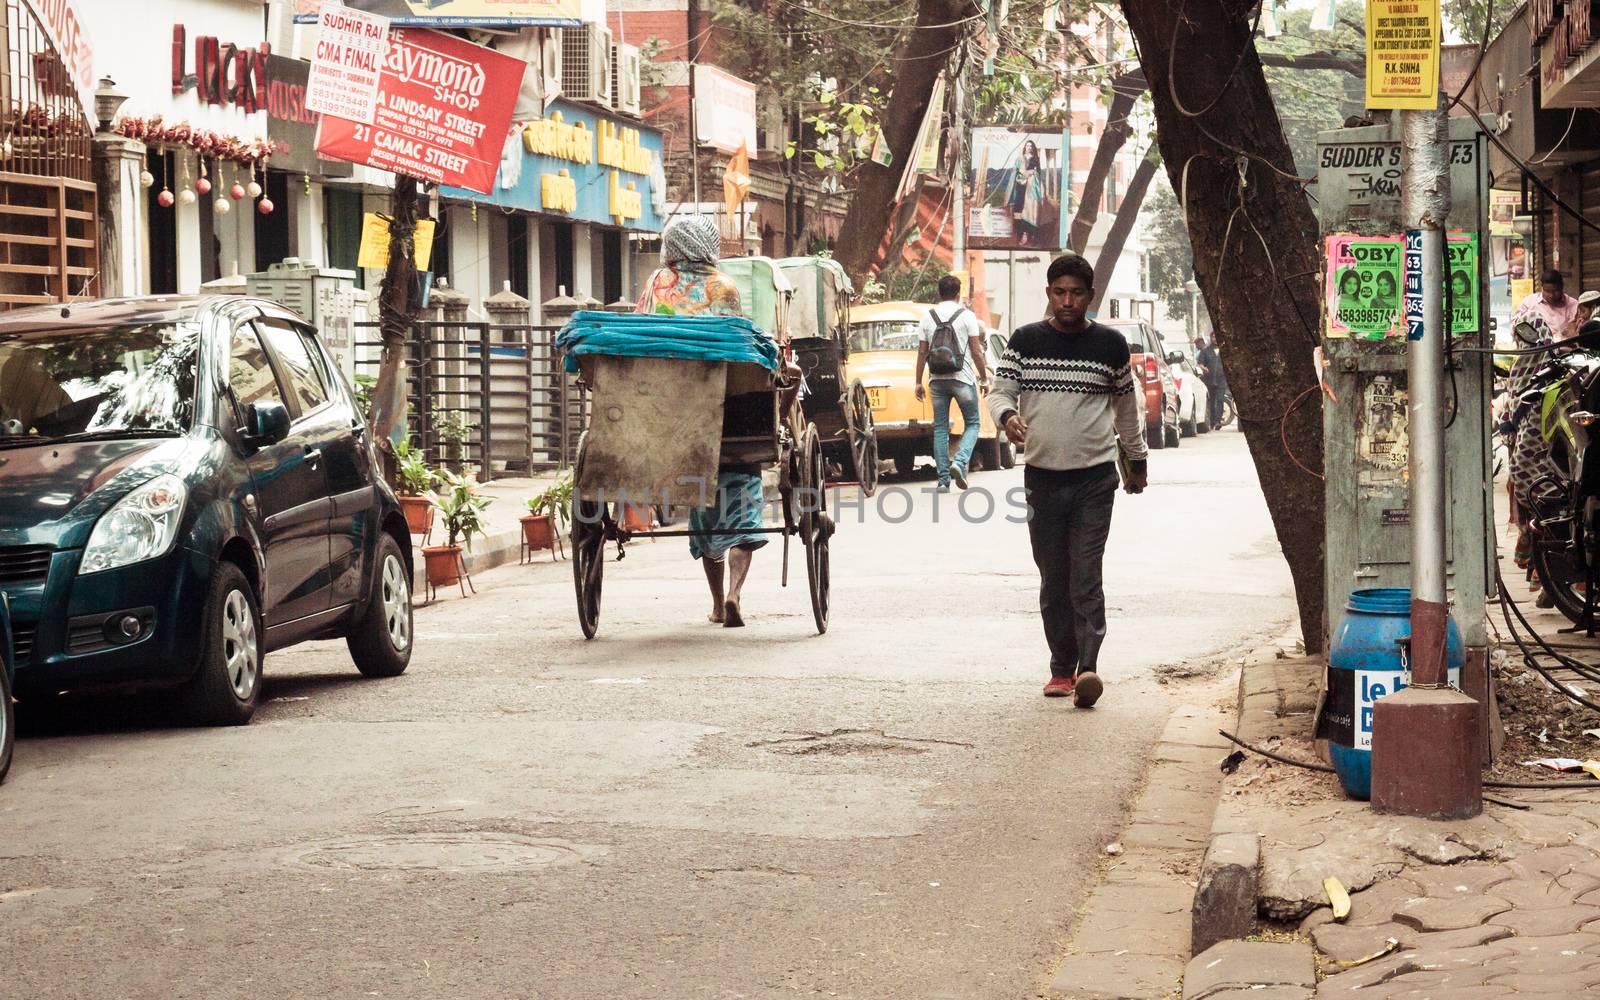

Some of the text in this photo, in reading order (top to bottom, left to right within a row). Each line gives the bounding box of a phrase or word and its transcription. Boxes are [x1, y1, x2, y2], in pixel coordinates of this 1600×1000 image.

[323, 13, 383, 40] SUDHIR RAI
[389, 28, 404, 43] HE
[317, 40, 377, 72] CMA FINAL
[374, 39, 486, 97] Raymond
[1385, 62, 1420, 74] R.K. SINHA
[433, 86, 480, 112] SHOP
[389, 94, 443, 123] LINDSAY
[443, 113, 486, 139] STREET
[353, 124, 469, 174] 21 CAMAC STREET
[1320, 146, 1401, 168] SUDDER S
[1341, 244, 1395, 261] ROBY
[1448, 248, 1468, 260] BY
[1452, 308, 1472, 322] 744
